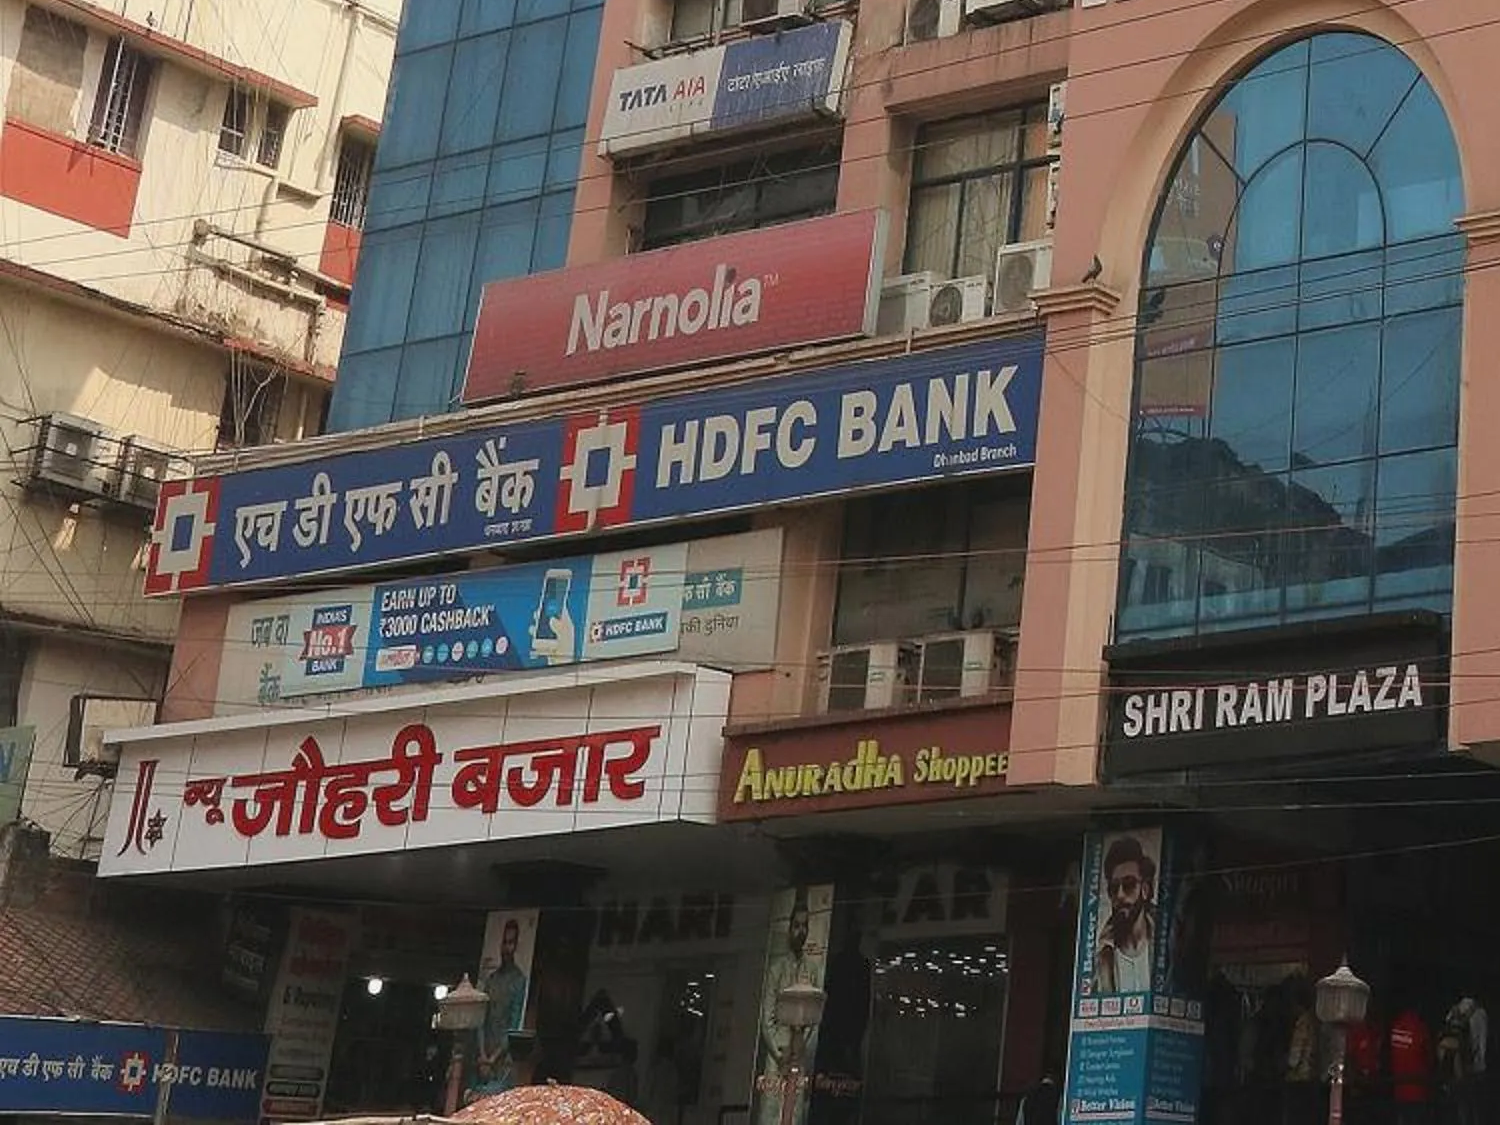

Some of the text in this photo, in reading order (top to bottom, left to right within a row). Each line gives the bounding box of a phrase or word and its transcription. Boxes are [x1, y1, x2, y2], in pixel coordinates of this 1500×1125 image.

[619, 83, 667, 112] TATA
[673, 75, 705, 101] AIA
[727, 75, 750, 92] टाटा
[565, 263, 762, 356] Narnolia
[655, 365, 1019, 488] HDFC BANK
[934, 442, 1018, 469] Dhanbad Branch
[234, 437, 539, 568] एच डी एफ सी बैंक
[381, 584, 457, 612] EARN UP TO
[605, 621, 633, 637] HDFC
[634, 617, 665, 634] BANK
[307, 630, 347, 658] No.1
[311, 661, 338, 674] BANK
[1123, 664, 1423, 737] SHRI RAM PLAZA
[229, 723, 443, 841] जौहरी
[451, 725, 662, 814] बजार
[207, 1065, 257, 1090] BANK
